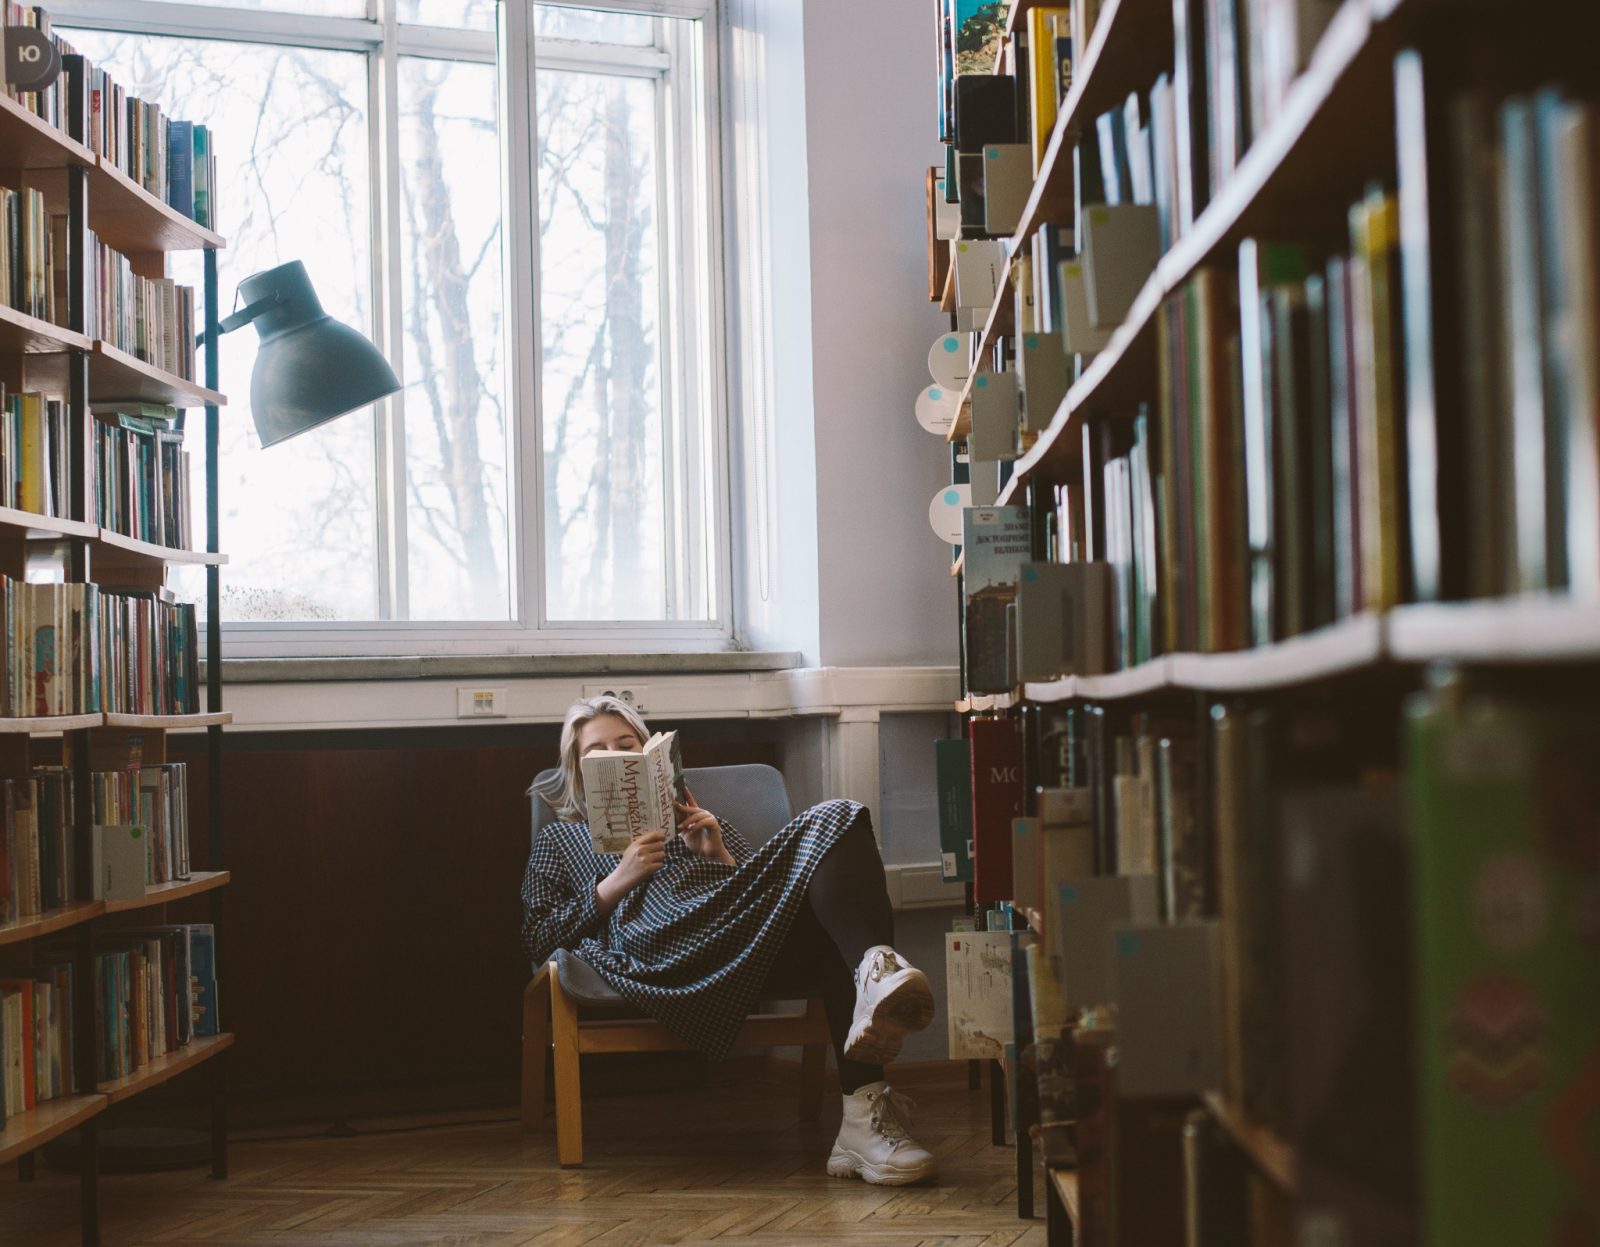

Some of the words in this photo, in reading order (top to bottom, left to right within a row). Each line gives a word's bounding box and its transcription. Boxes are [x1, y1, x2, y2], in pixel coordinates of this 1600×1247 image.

[18, 45, 41, 62] Ю
[620, 758, 644, 842] Муракам
[654, 748, 672, 838] Муракам
